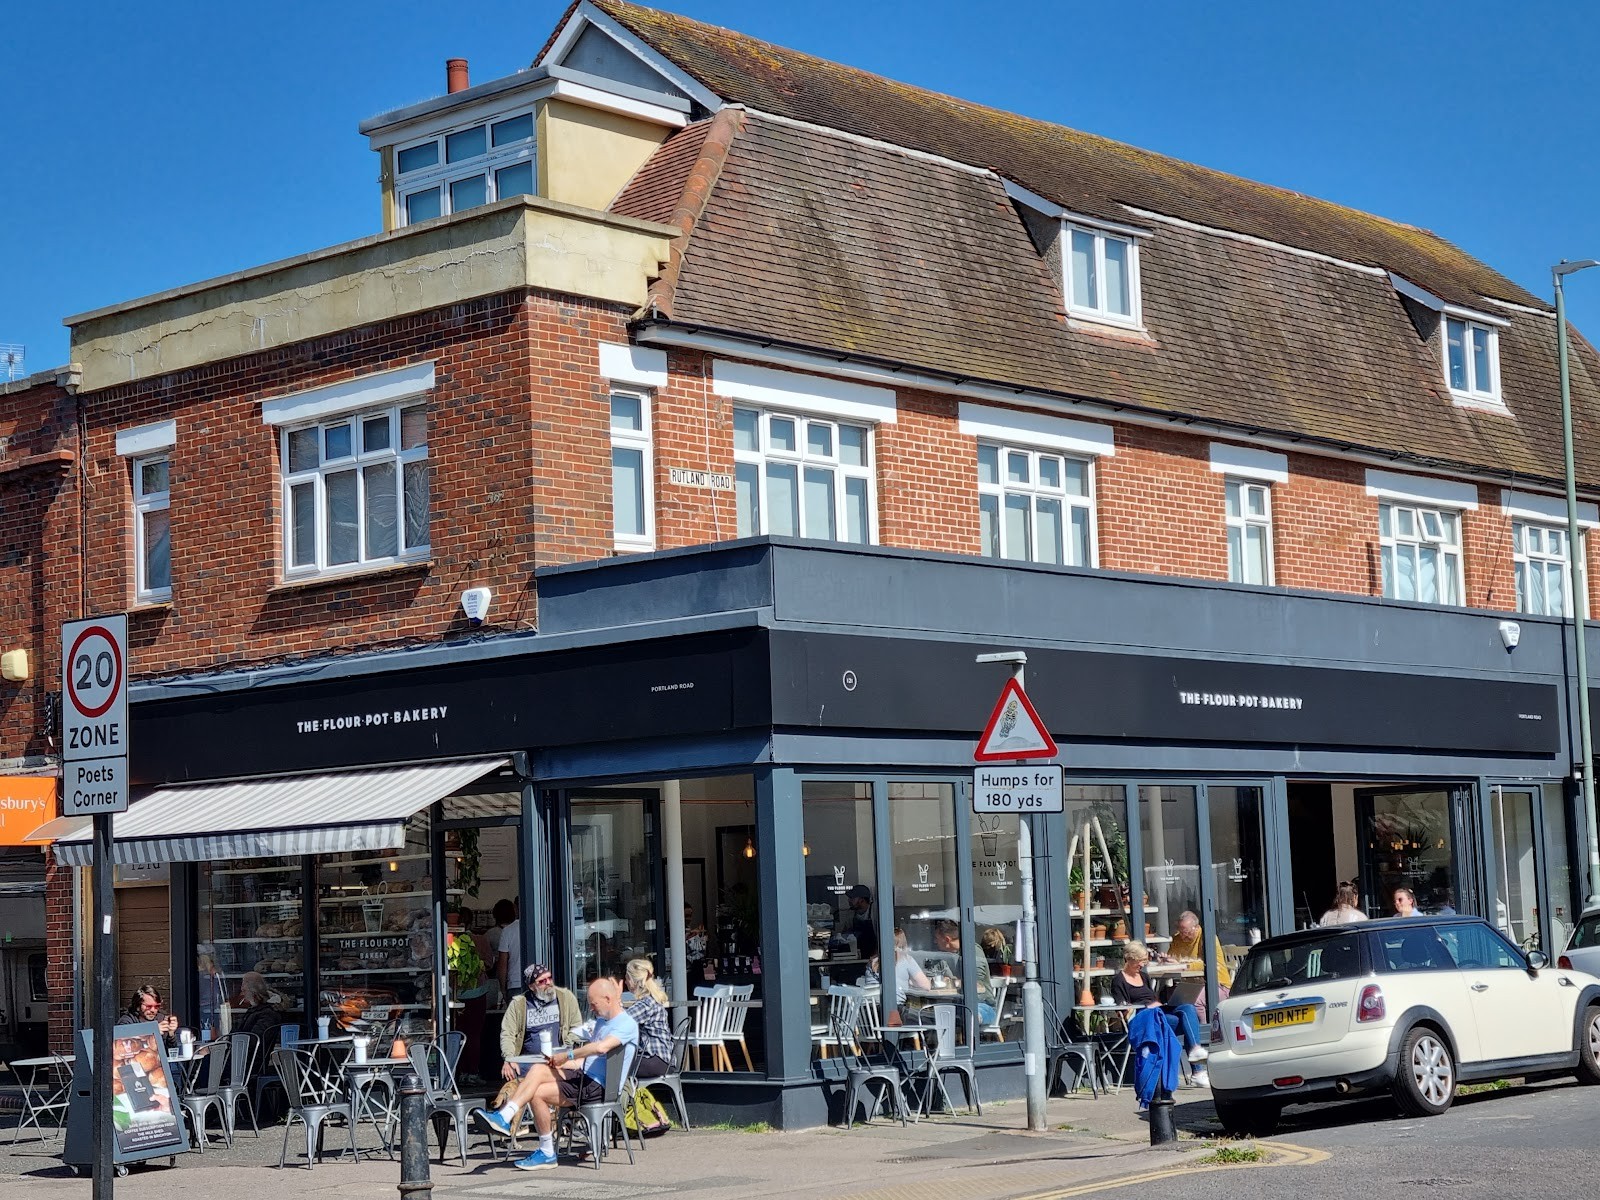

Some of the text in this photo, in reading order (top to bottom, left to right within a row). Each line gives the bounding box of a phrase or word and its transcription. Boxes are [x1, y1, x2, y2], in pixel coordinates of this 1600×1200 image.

[672, 470, 730, 489] RUTLAND ROAD
[75, 651, 114, 690] 20
[651, 684, 678, 692] PORTLAND
[1180, 692, 1303, 710] THE FLOUR POT BAKERY
[297, 706, 448, 733] THE FLOUR POT BAKERY
[69, 723, 119, 749] ZONE
[77, 765, 114, 785] Poets
[981, 773, 1054, 789] Humps for
[73, 790, 118, 808] Corner
[986, 793, 1043, 809] 180 yds
[340, 938, 410, 948] THE FLOUR POT
[360, 952, 388, 960] BAKERY
[1260, 1008, 1309, 1026] DP10 NTF
[1235, 1026, 1246, 1041] L
